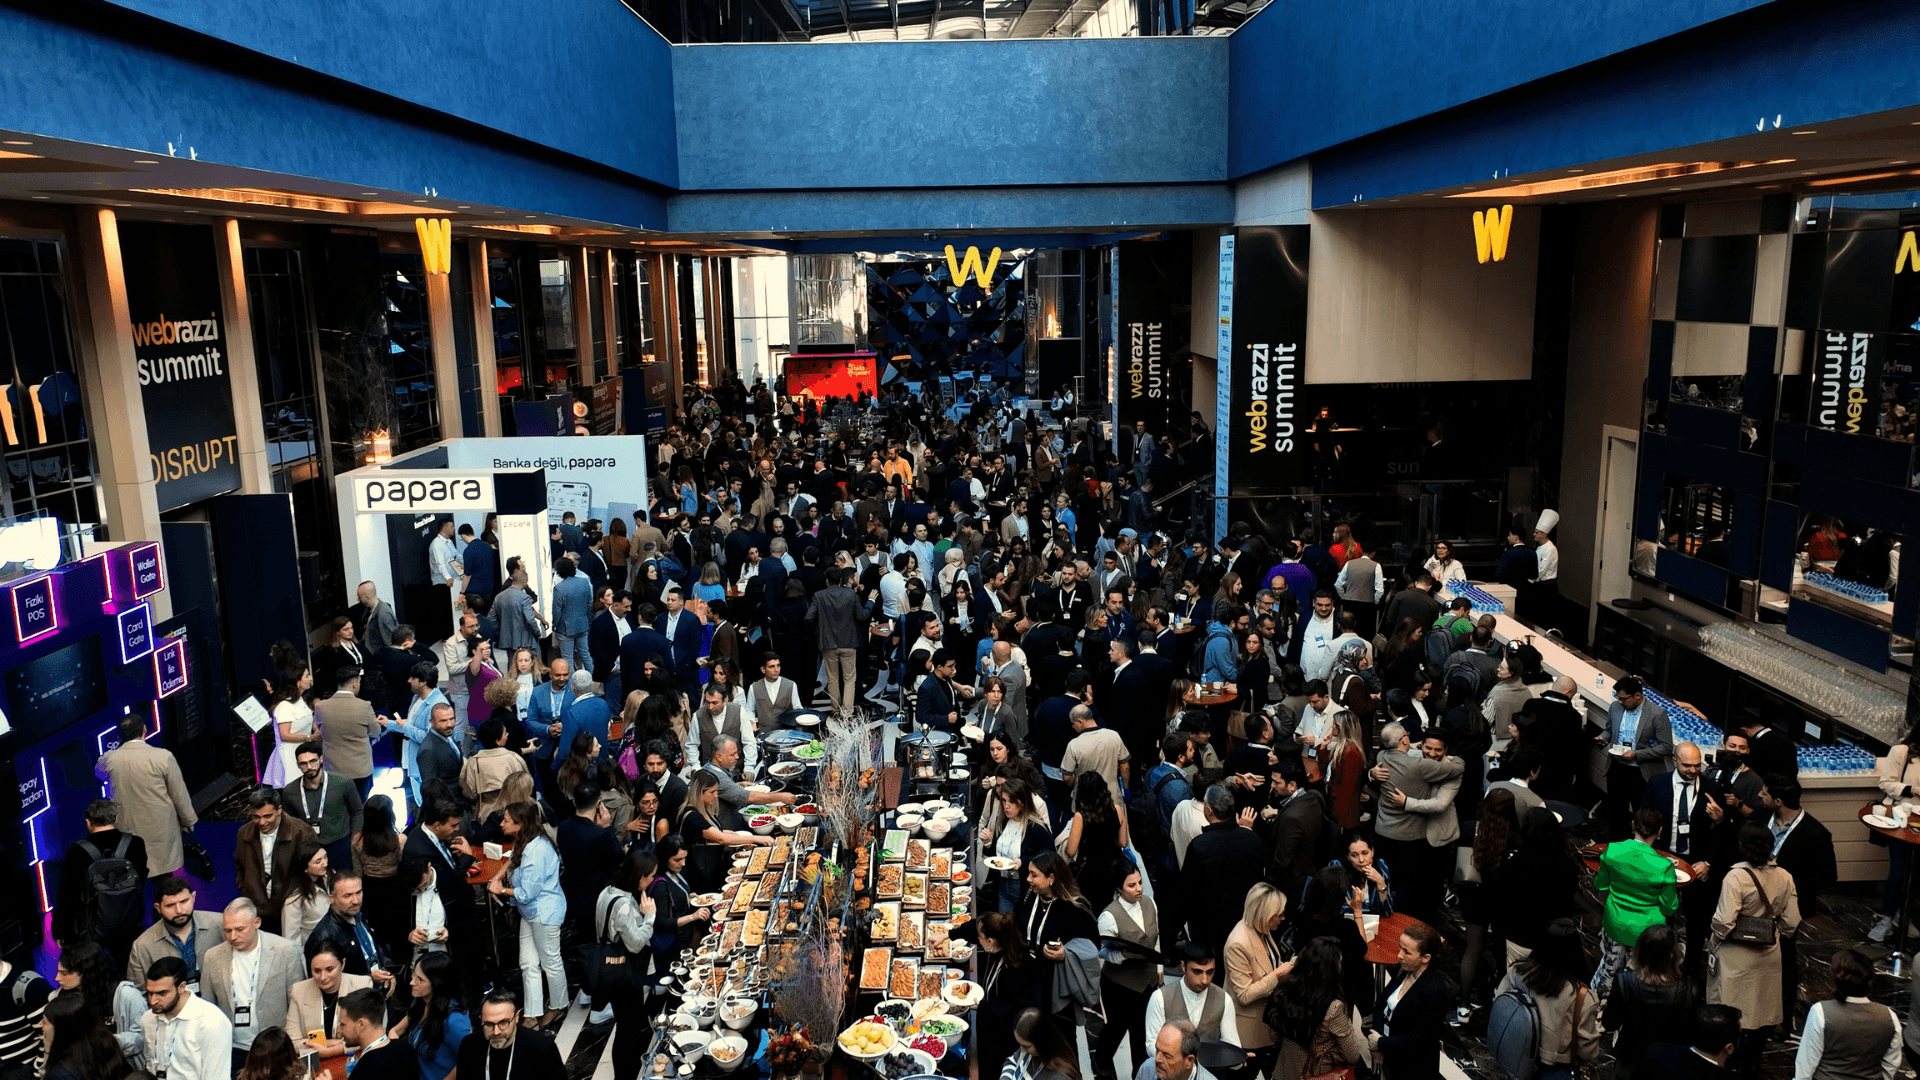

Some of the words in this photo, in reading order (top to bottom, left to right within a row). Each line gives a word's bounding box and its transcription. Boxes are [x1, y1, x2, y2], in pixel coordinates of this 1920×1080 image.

[415, 217, 452, 274] W
[1473, 205, 1514, 264] W
[944, 244, 1002, 288] W
[131, 311, 219, 347] webrazzi
[137, 347, 222, 386] summit
[1127, 322, 1144, 399] webrazzi
[1145, 322, 1162, 399] summit
[1245, 343, 1269, 453] webrazzi
[1273, 342, 1297, 453] summit
[150, 435, 237, 485] DISRUPT
[493, 457, 531, 469] Banka
[533, 457, 567, 470] değil,
[569, 458, 616, 470] papara
[366, 479, 481, 508] papara
[28, 608, 46, 623] POS
[127, 618, 144, 634] Card
